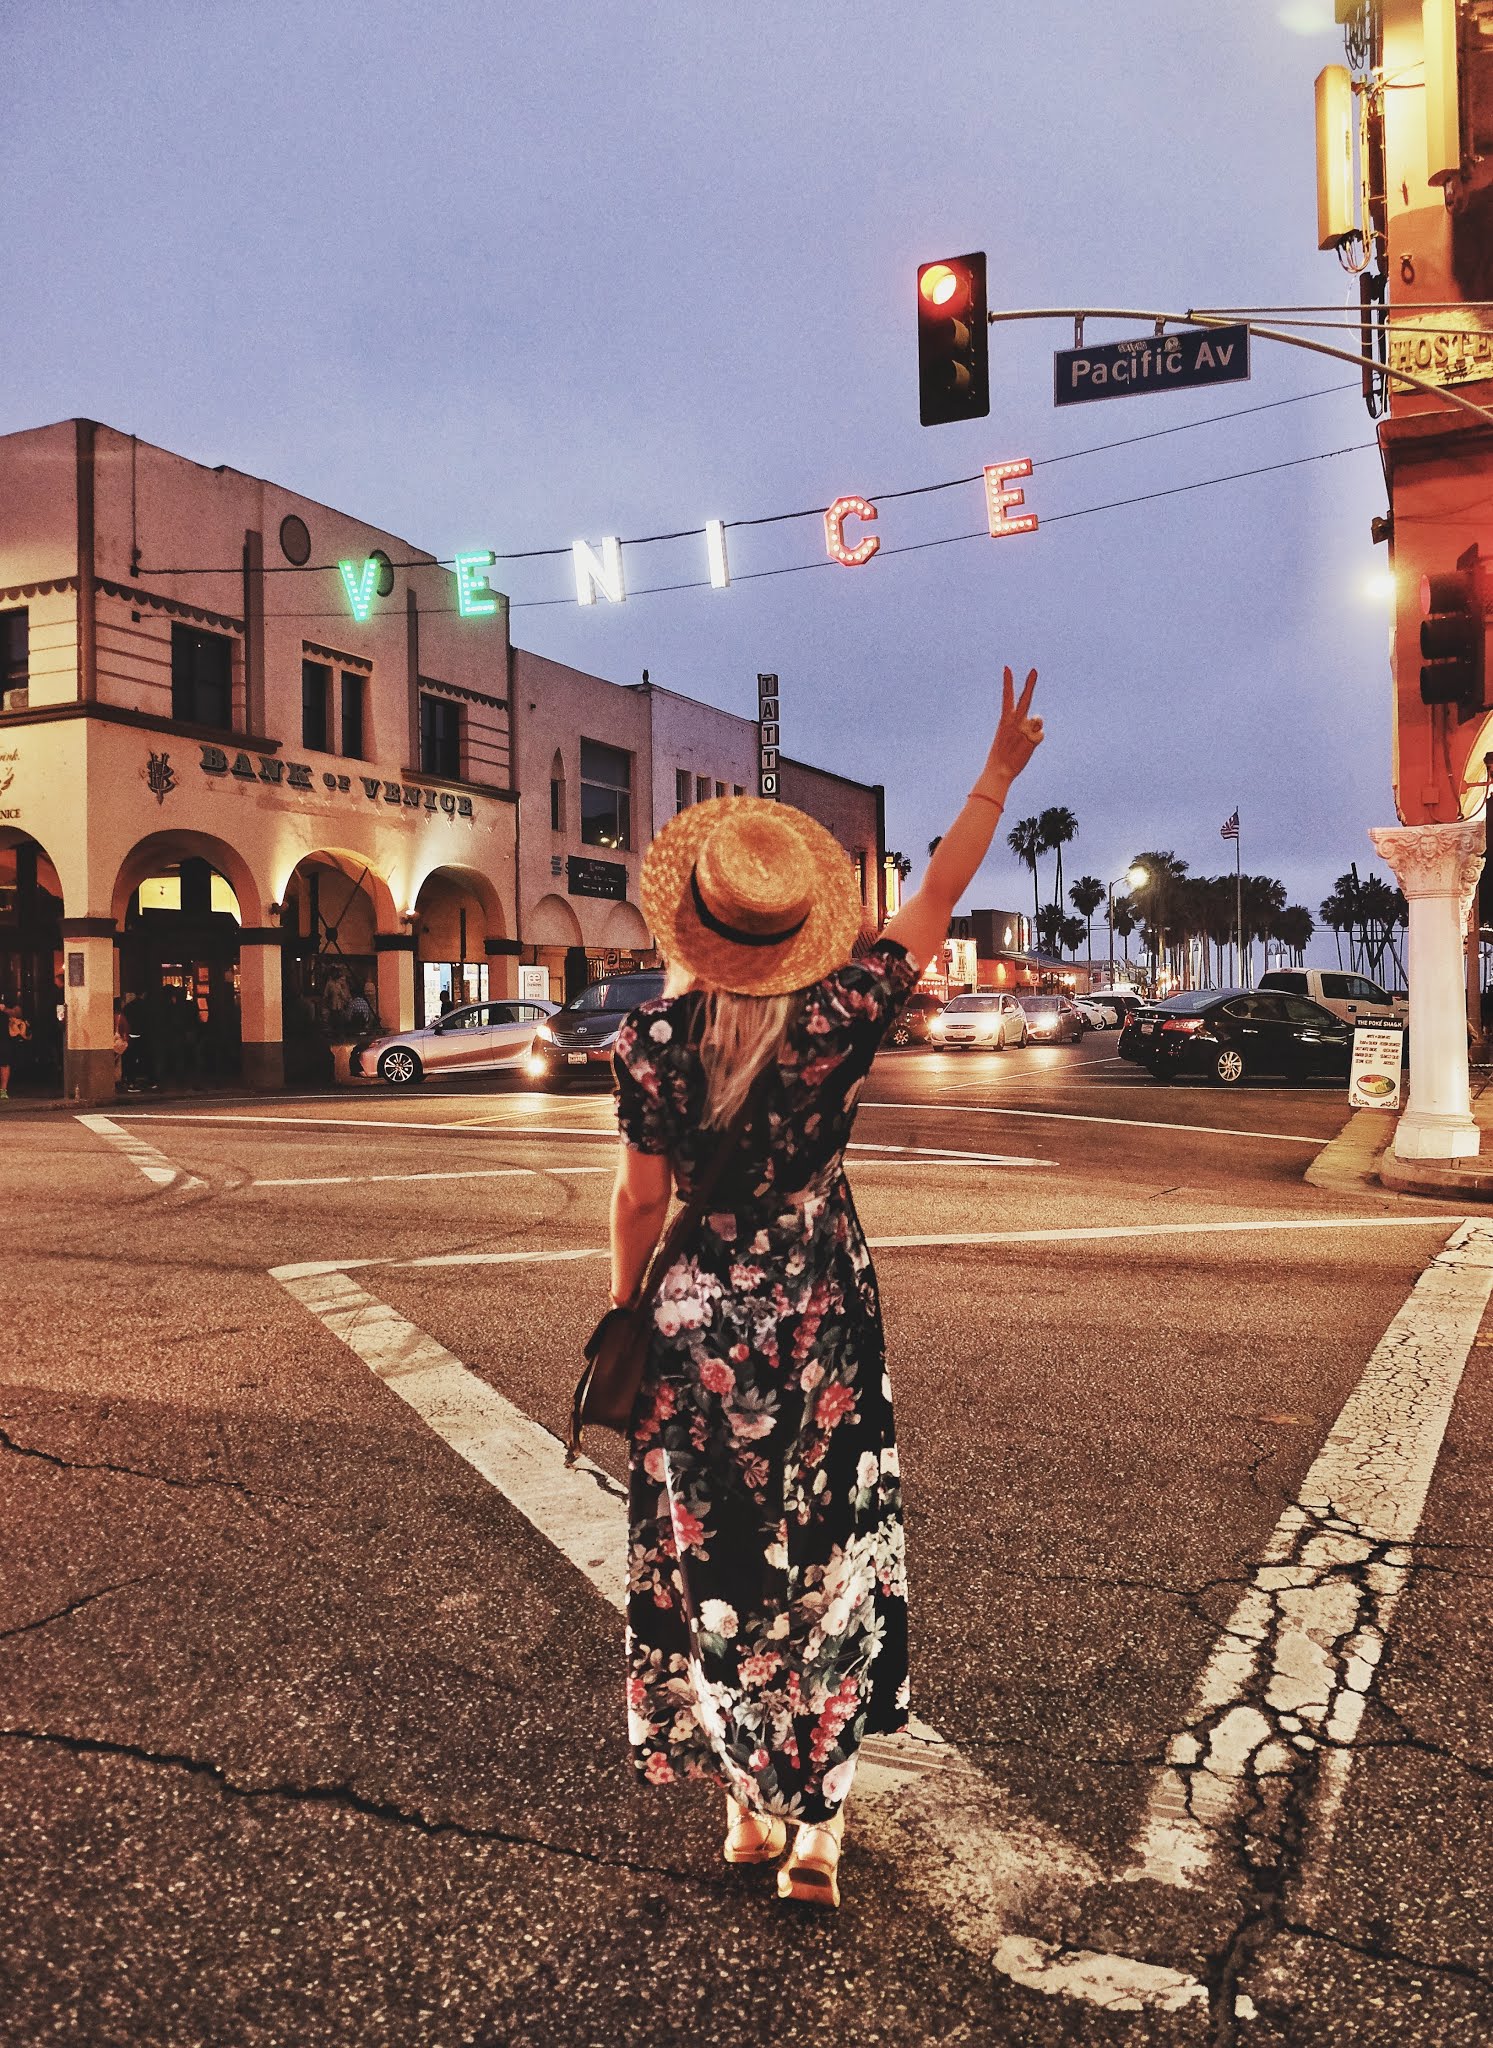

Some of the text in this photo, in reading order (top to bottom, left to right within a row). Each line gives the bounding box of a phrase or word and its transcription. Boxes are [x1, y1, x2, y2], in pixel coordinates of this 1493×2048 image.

[1071, 342, 1235, 387] Pacific Av
[339, 458, 1038, 621] VENICE
[200, 746, 474, 817] BANK OF VENICE
